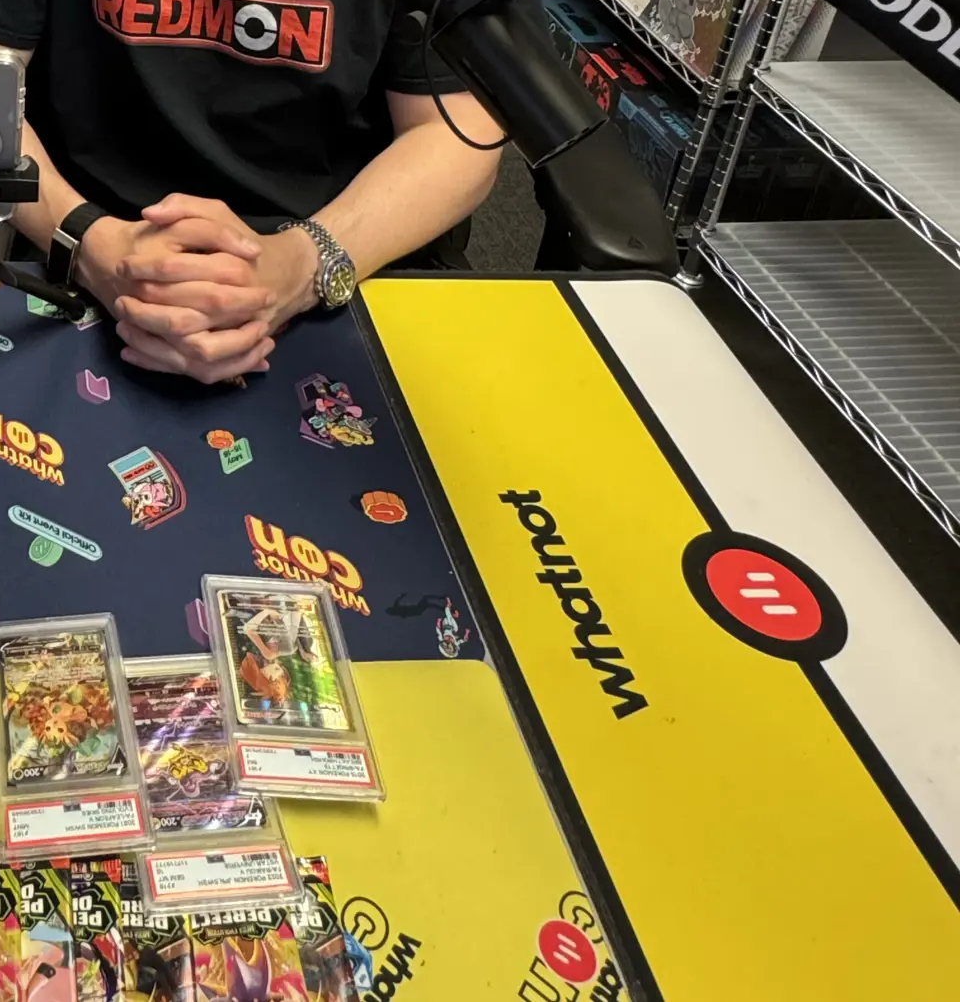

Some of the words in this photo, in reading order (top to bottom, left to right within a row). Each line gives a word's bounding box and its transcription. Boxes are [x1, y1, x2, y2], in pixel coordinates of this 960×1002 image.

[18, 509, 33, 524] Kit
[32, 516, 61, 538] Event
[61, 530, 97, 554] Official
[251, 548, 372, 617] whtnot
[498, 489, 650, 721] whatnot
[86, 820, 120, 830] POKEMON
[233, 874, 267, 883] POKEMON
